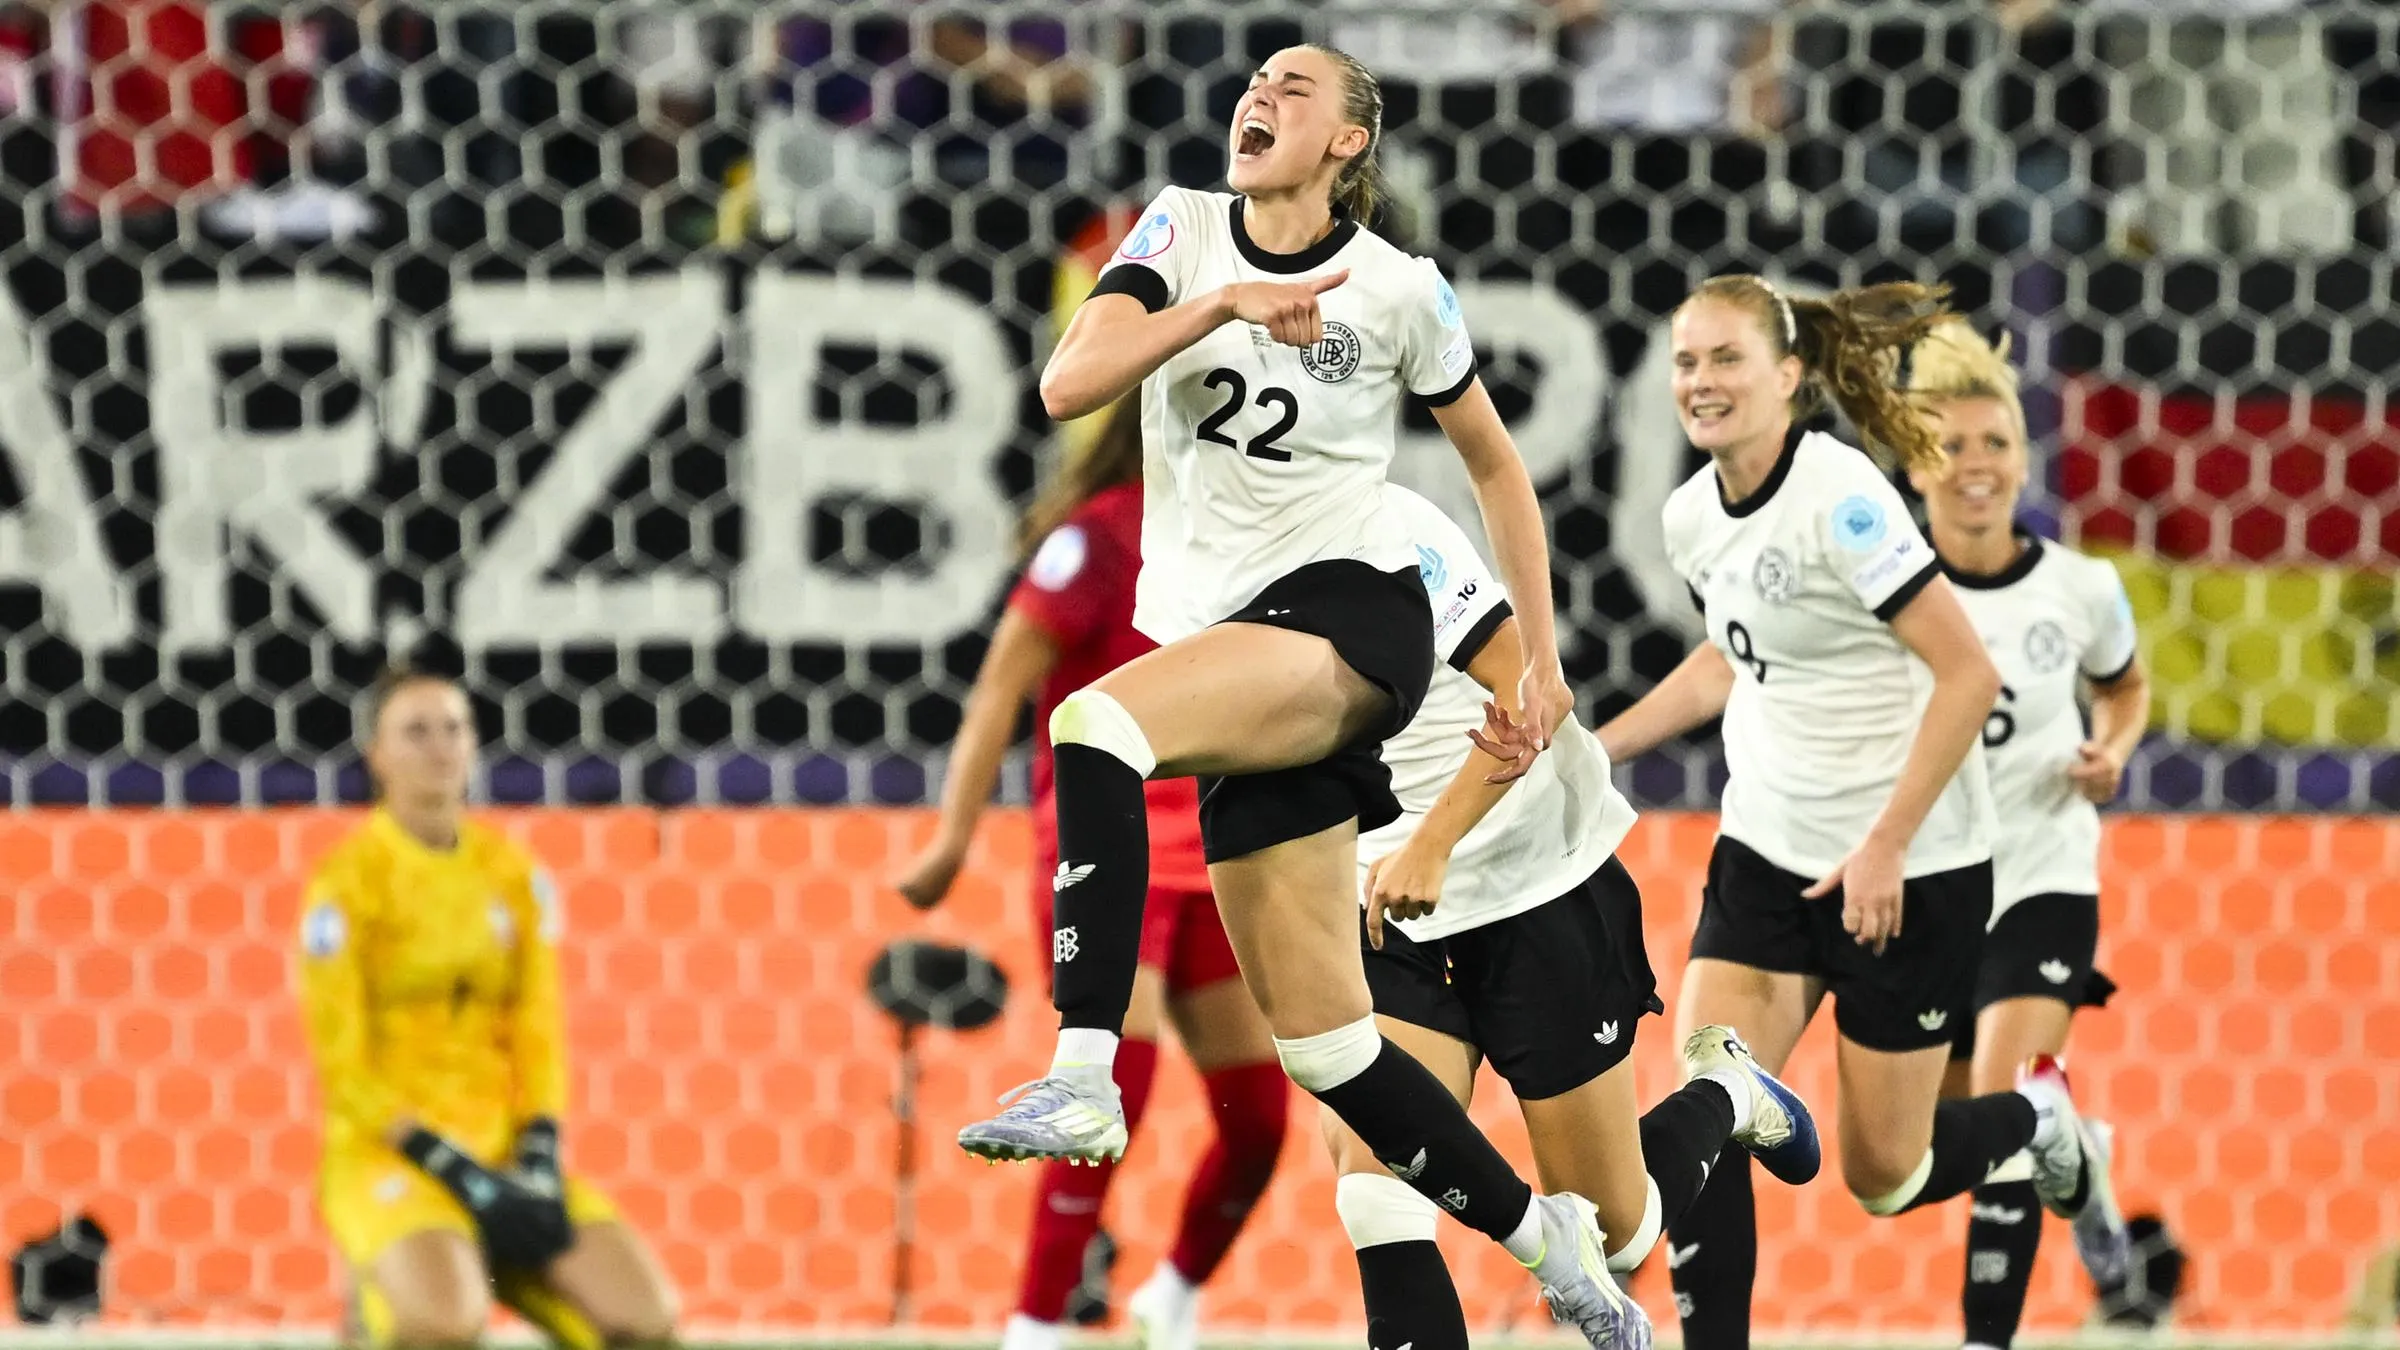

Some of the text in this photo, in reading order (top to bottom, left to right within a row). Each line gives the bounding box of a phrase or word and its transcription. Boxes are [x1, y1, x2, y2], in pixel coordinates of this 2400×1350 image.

[1196, 367, 1299, 462] 22
[1727, 620, 1766, 684] 9
[1983, 685, 2016, 748] 6
